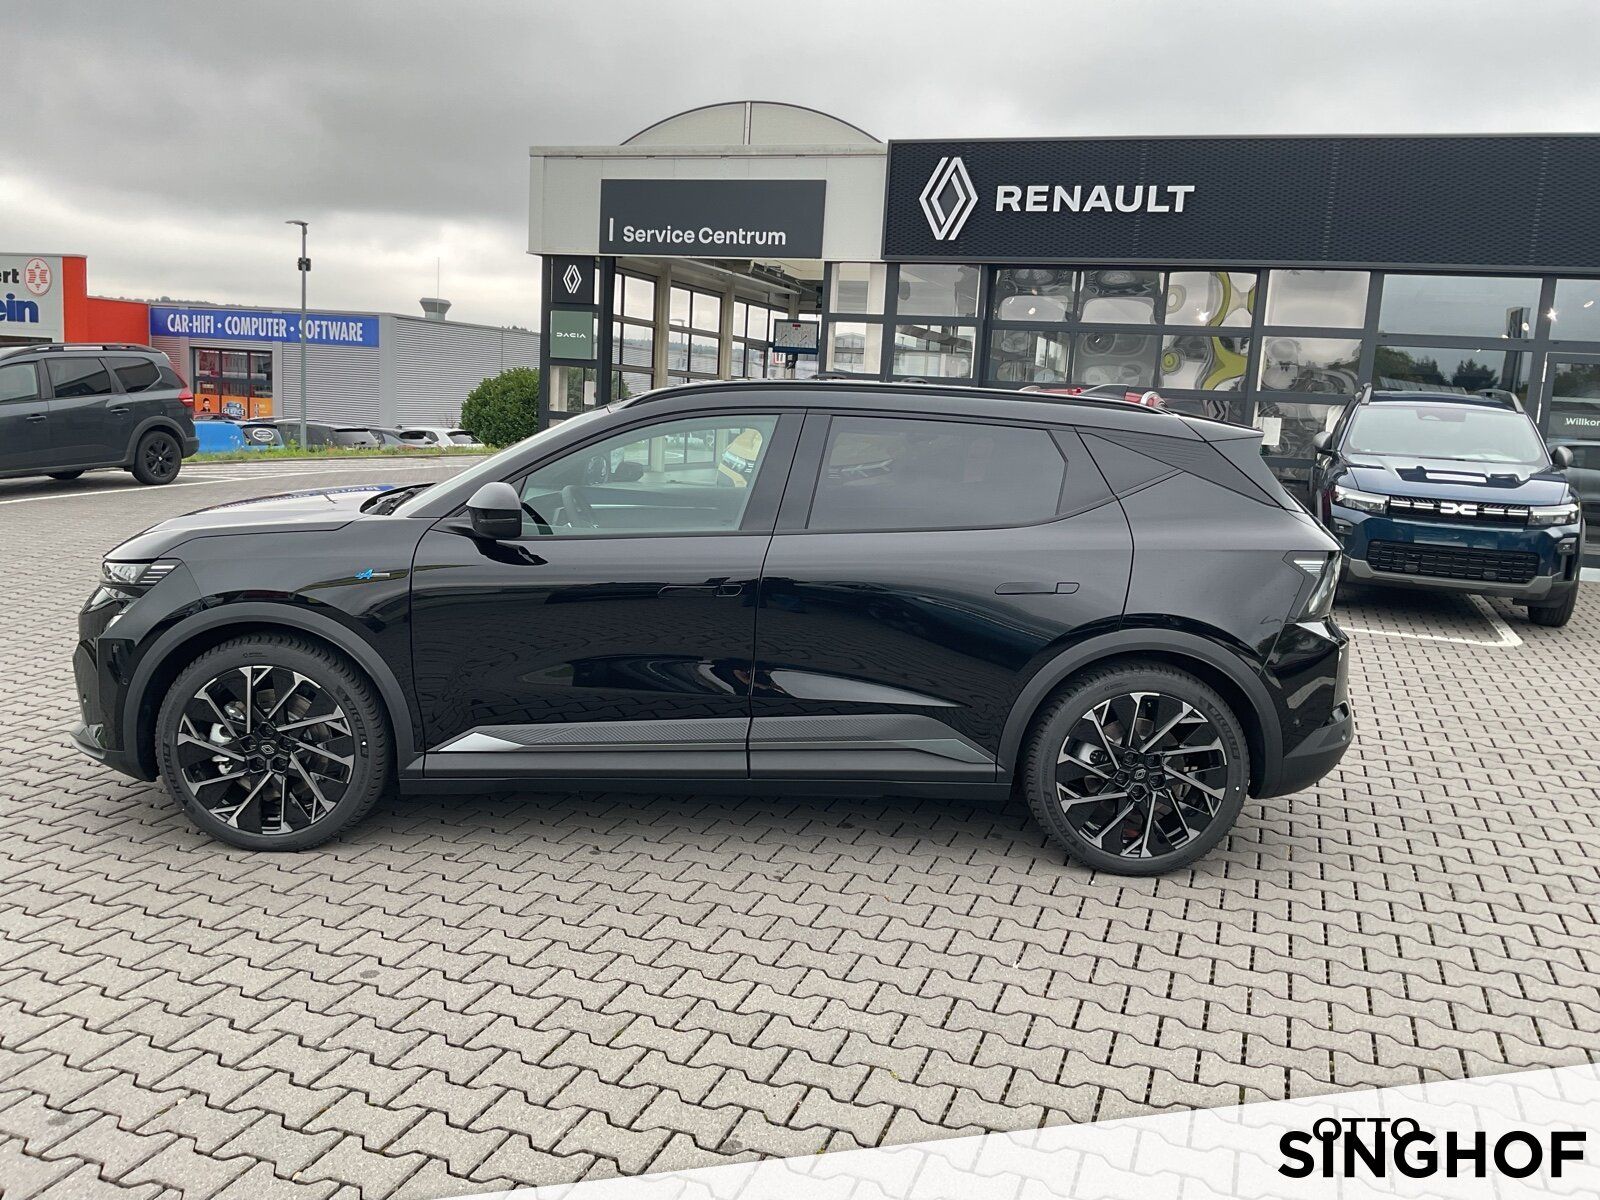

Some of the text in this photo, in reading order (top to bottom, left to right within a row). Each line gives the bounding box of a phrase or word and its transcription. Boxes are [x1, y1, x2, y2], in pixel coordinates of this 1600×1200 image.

[995, 185, 1195, 213] RENAULT
[623, 226, 786, 245] Service Centrum
[167, 313, 214, 334] CAR-HIFI
[224, 315, 287, 338] COMPUTER
